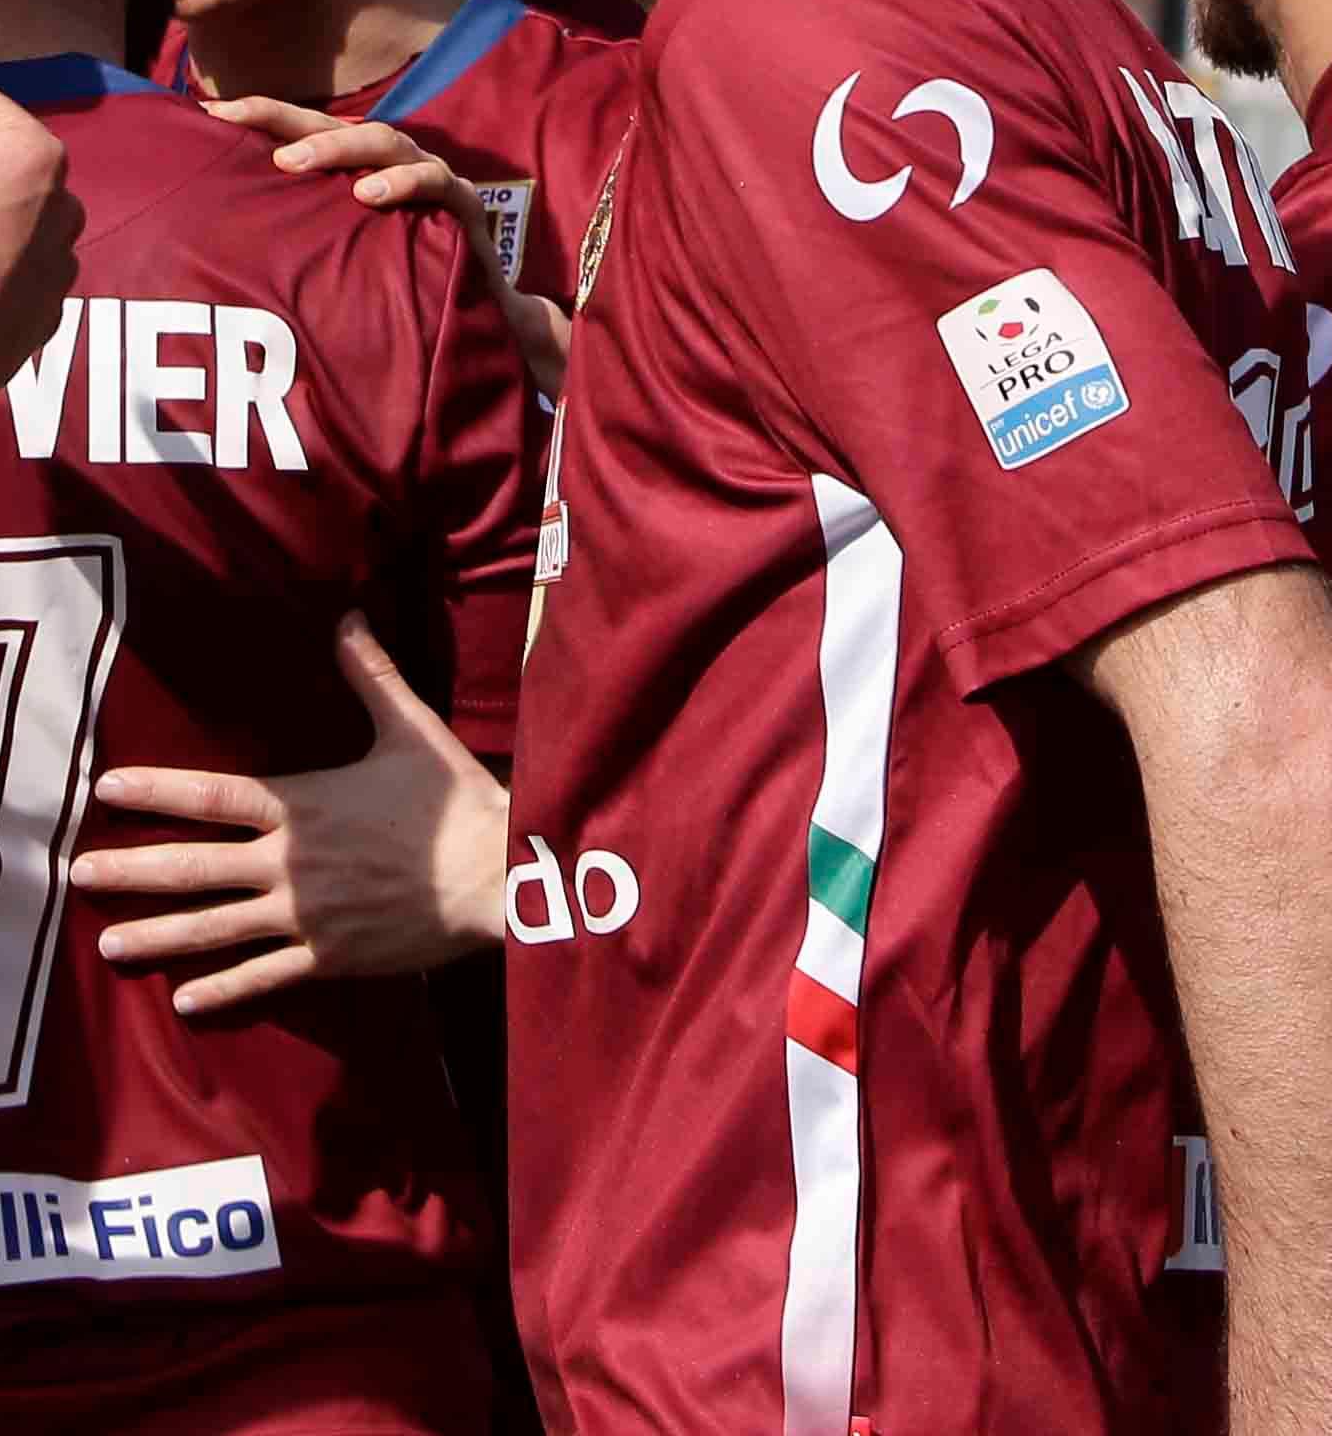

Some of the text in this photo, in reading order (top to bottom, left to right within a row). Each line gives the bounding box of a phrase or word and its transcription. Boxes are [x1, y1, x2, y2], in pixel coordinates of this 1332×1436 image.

[987, 331, 1063, 375] LEGA
[997, 350, 1075, 402] PRO
[997, 389, 1079, 457] unicef
[88, 1195, 266, 1261] Fico
